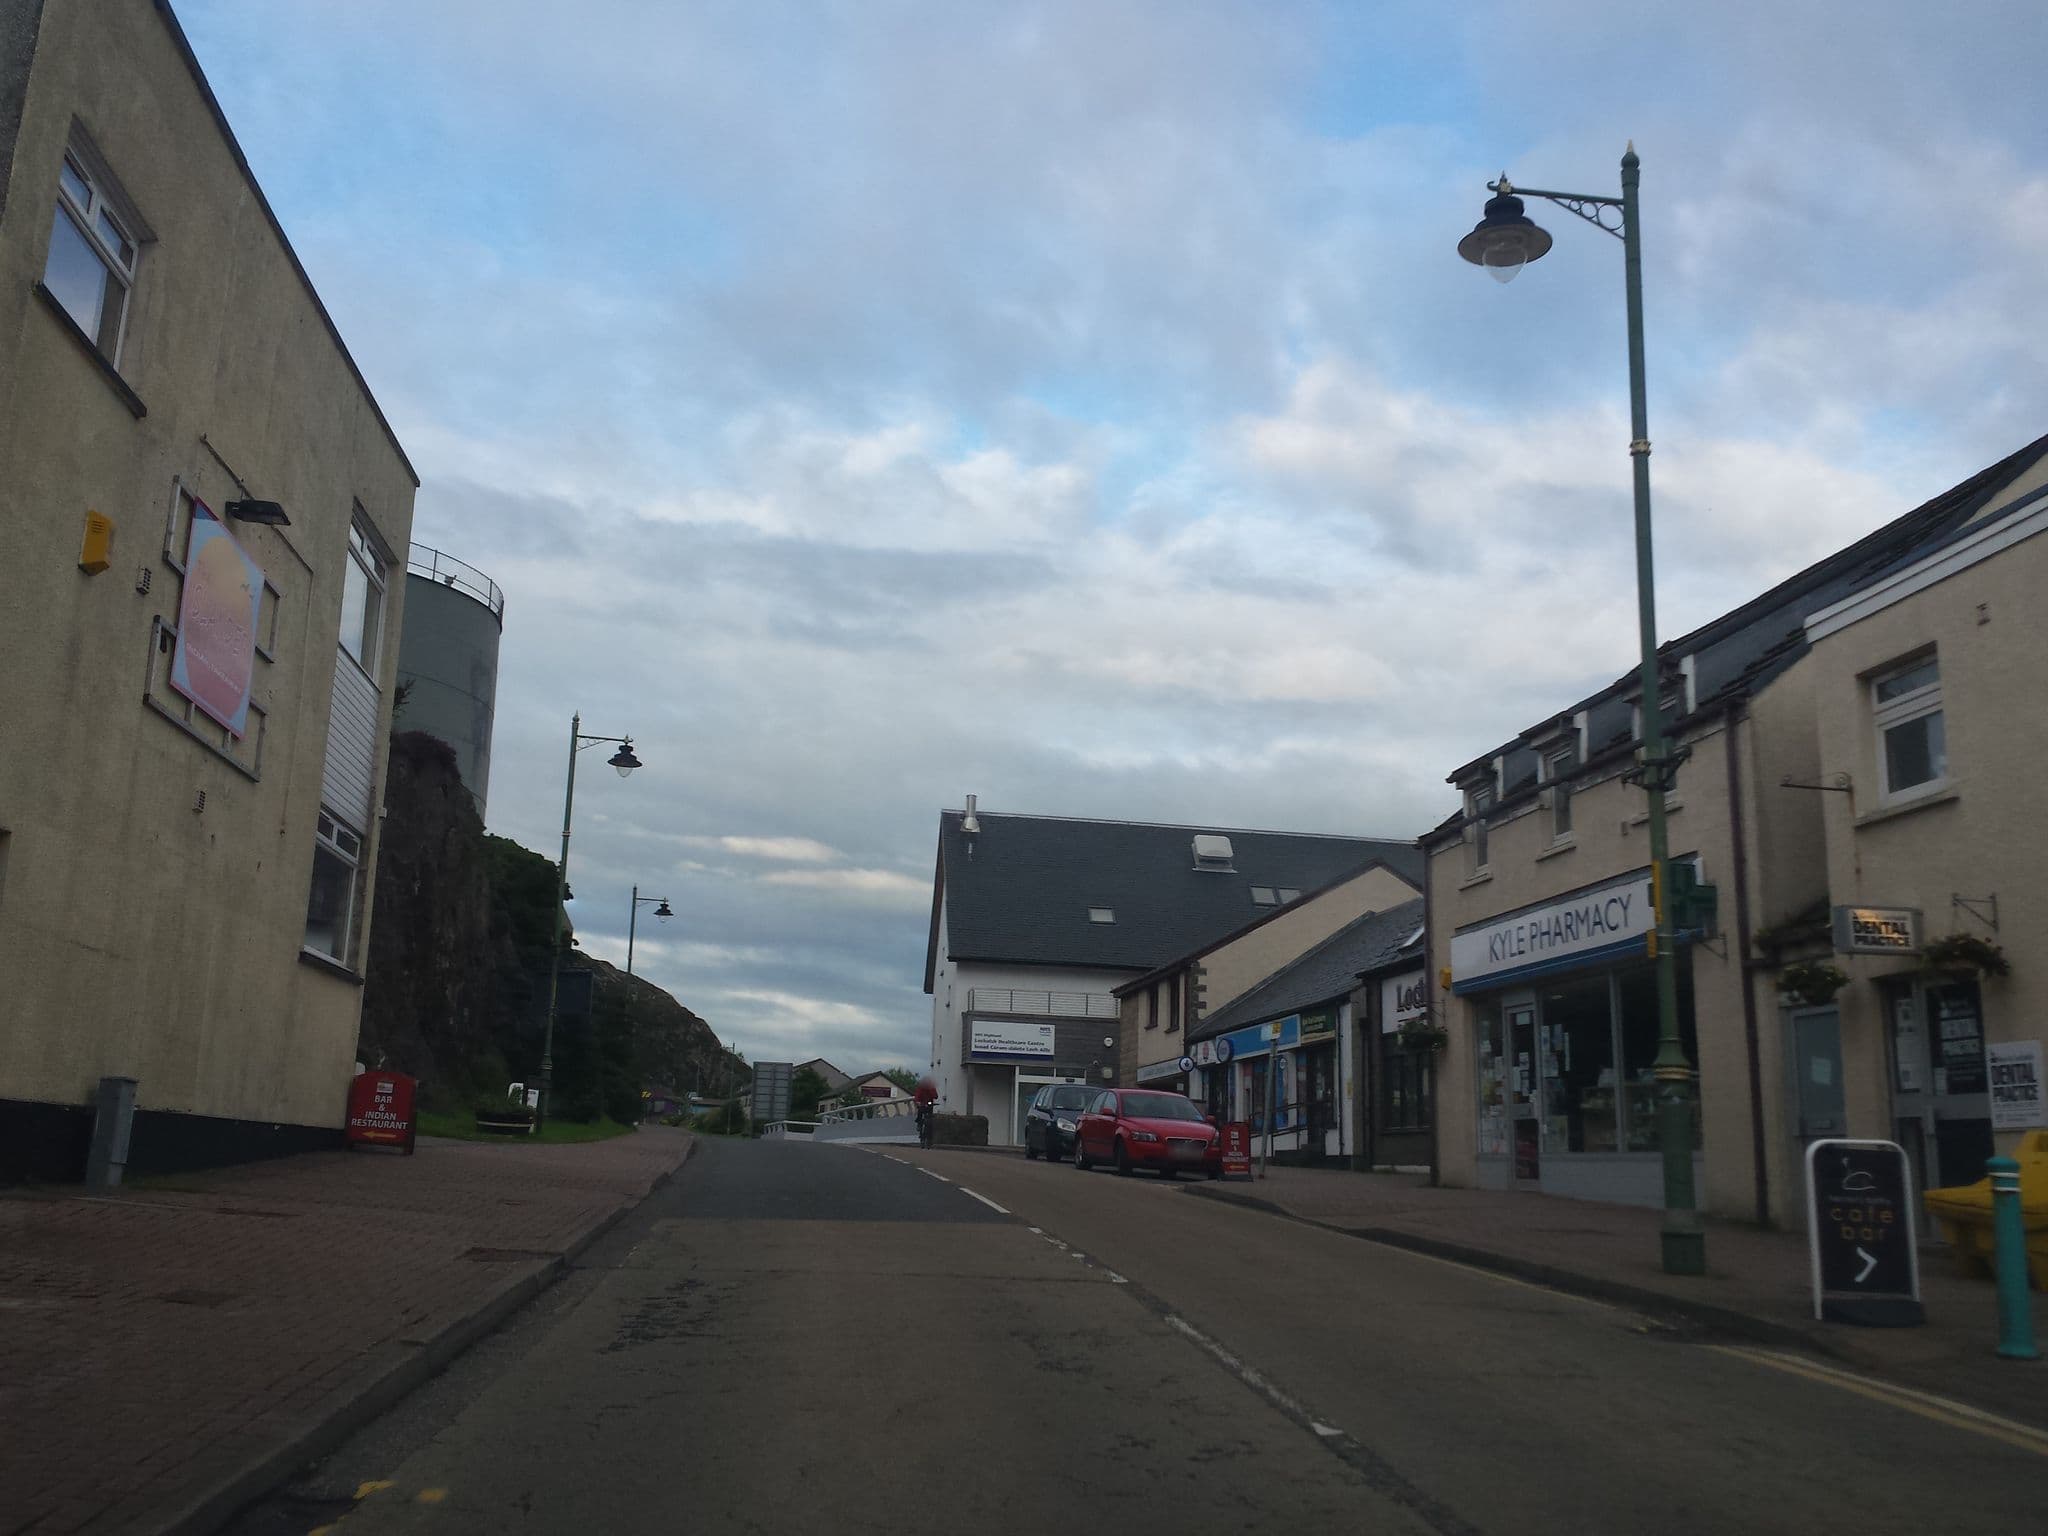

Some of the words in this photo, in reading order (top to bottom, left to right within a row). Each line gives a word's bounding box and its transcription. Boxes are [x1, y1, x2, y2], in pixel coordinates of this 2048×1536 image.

[1489, 925, 1526, 963] KYLE
[1529, 893, 1632, 952] PHARMACY
[1852, 920, 1910, 935] DENTAL
[1854, 934, 1912, 948] PRACTICE
[1991, 1063, 2037, 1087] DENTAL
[374, 1094, 393, 1104] BAR
[1993, 1084, 2040, 1103] PRACTICE
[378, 1103, 386, 1112] &
[365, 1111, 397, 1121] INDIAN
[351, 1118, 409, 1130] RESTAURANT
[1830, 1206, 1895, 1224] cafe
[1840, 1224, 1888, 1241] bar
